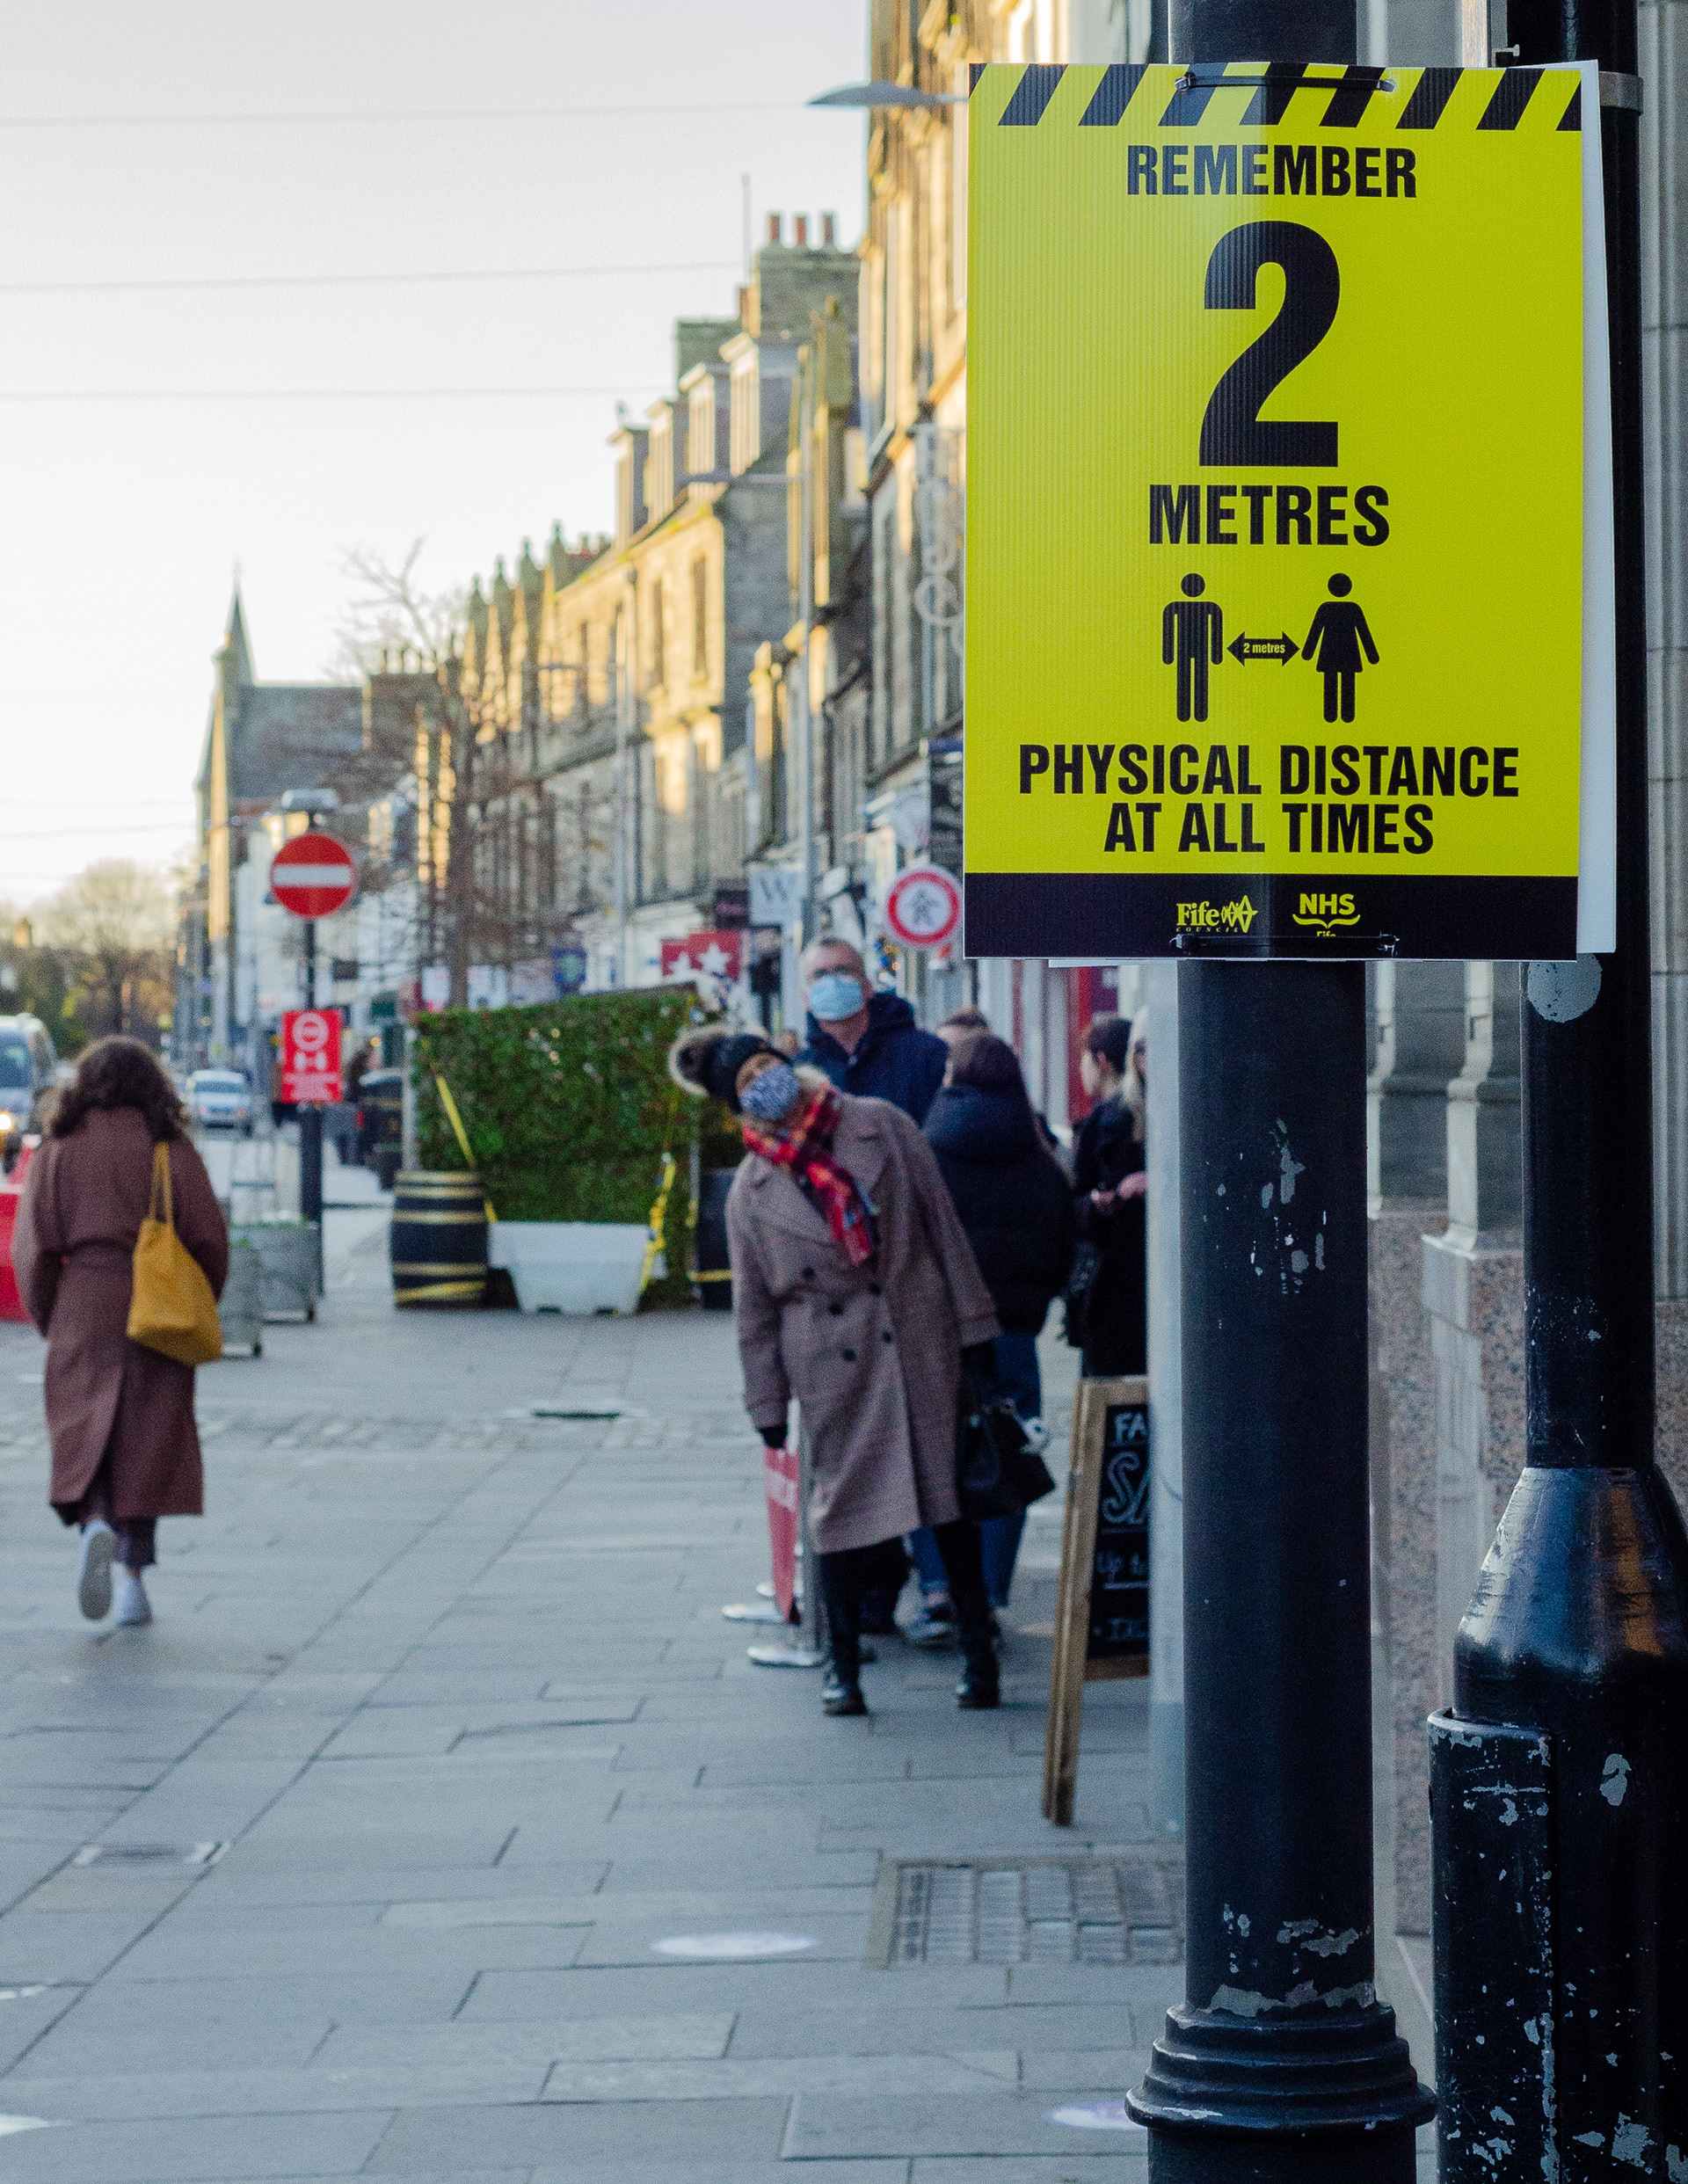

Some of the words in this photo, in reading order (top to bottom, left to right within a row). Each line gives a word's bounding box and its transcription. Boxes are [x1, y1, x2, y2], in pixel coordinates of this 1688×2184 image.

[1128, 145, 1416, 198] REMEMBER
[1200, 220, 1340, 467] 2
[1150, 484, 1389, 546] METRES
[1243, 642, 1250, 653] 2
[1252, 643, 1285, 653] metres
[1020, 745, 1262, 795] PHYSICAL
[1281, 745, 1518, 797] DISTANCE
[1104, 803, 1160, 852] AT
[1178, 803, 1265, 852] ALL
[1283, 804, 1433, 854] TIMES
[1176, 901, 1219, 926] Fife
[1299, 893, 1355, 915] NHS
